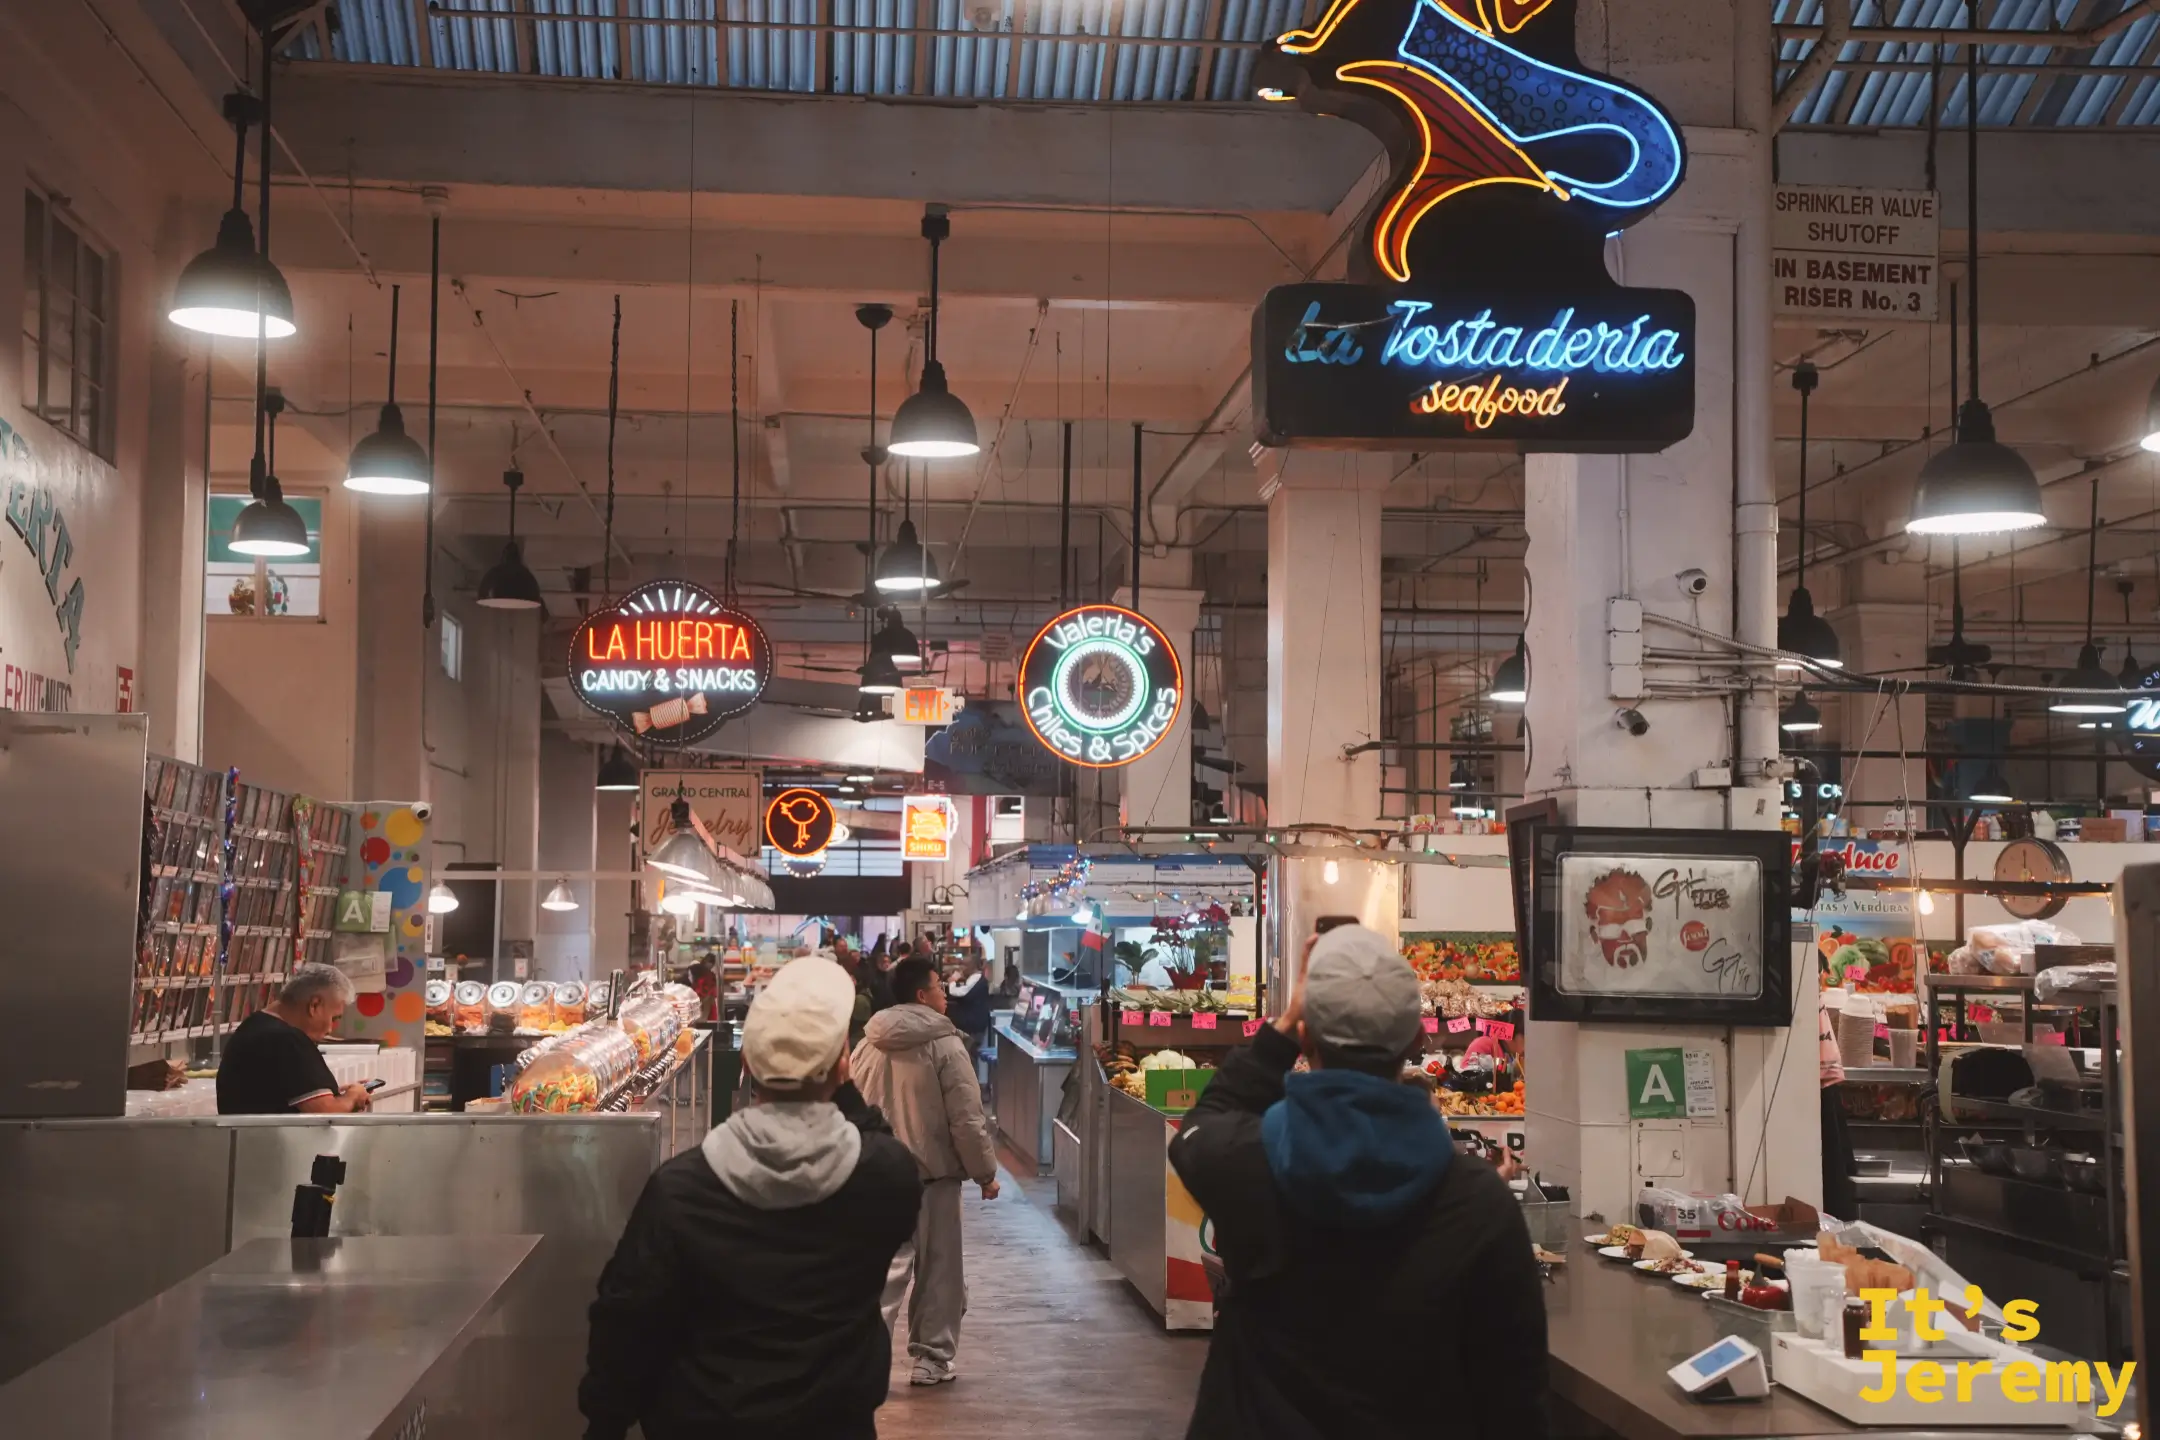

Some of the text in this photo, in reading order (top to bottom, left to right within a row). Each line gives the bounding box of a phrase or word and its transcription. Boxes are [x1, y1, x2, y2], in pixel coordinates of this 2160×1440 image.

[1775, 191, 1933, 218] SPRINKLER VALVE
[1808, 221, 1900, 245] SHUTOFF
[1774, 257, 1932, 285] IN BASEMENT
[1784, 285, 1922, 312] RISER No. 3
[1285, 299, 1685, 373] La Tostadería
[1413, 374, 1569, 429] seafood
[588, 619, 751, 661] LA HUERTA
[1043, 613, 1156, 656] Valeria's
[581, 667, 756, 692] CANDY & SNACKS
[904, 690, 945, 722] EXIT
[1028, 686, 1177, 761] Chiles & Spices
[699, 787, 752, 798] CENTRAL
[649, 807, 753, 846] Jeelry
[342, 899, 365, 924] A
[1639, 1063, 1676, 1104] A
[1677, 1207, 1697, 1220] 35
